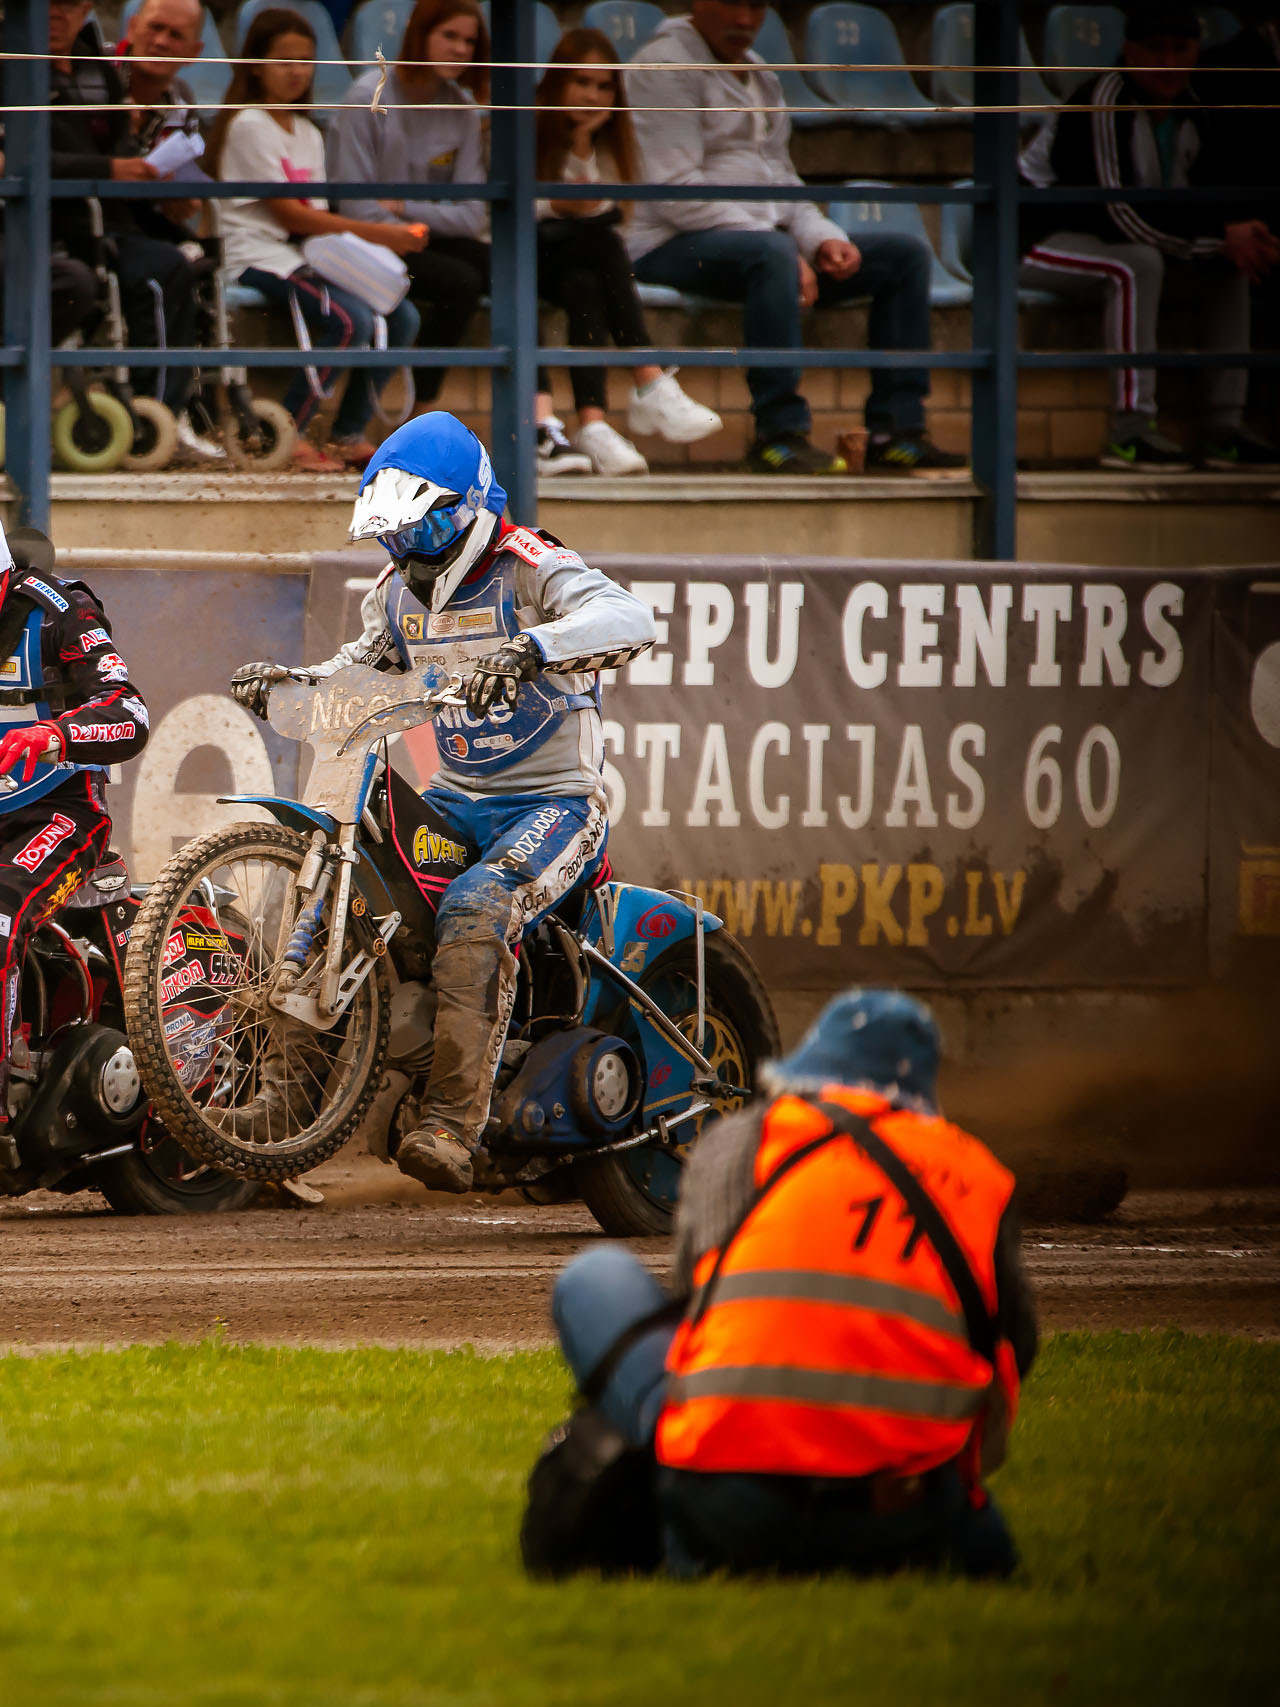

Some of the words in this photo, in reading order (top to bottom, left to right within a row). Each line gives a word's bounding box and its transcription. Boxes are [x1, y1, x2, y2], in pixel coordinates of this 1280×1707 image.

[35, 581, 68, 610] BERNER
[841, 581, 1185, 689] CENTRS
[310, 685, 395, 735] Nice
[603, 720, 987, 830] STACIJAS
[1024, 722, 1121, 829] 60
[166, 1015, 193, 1034] PROMA
